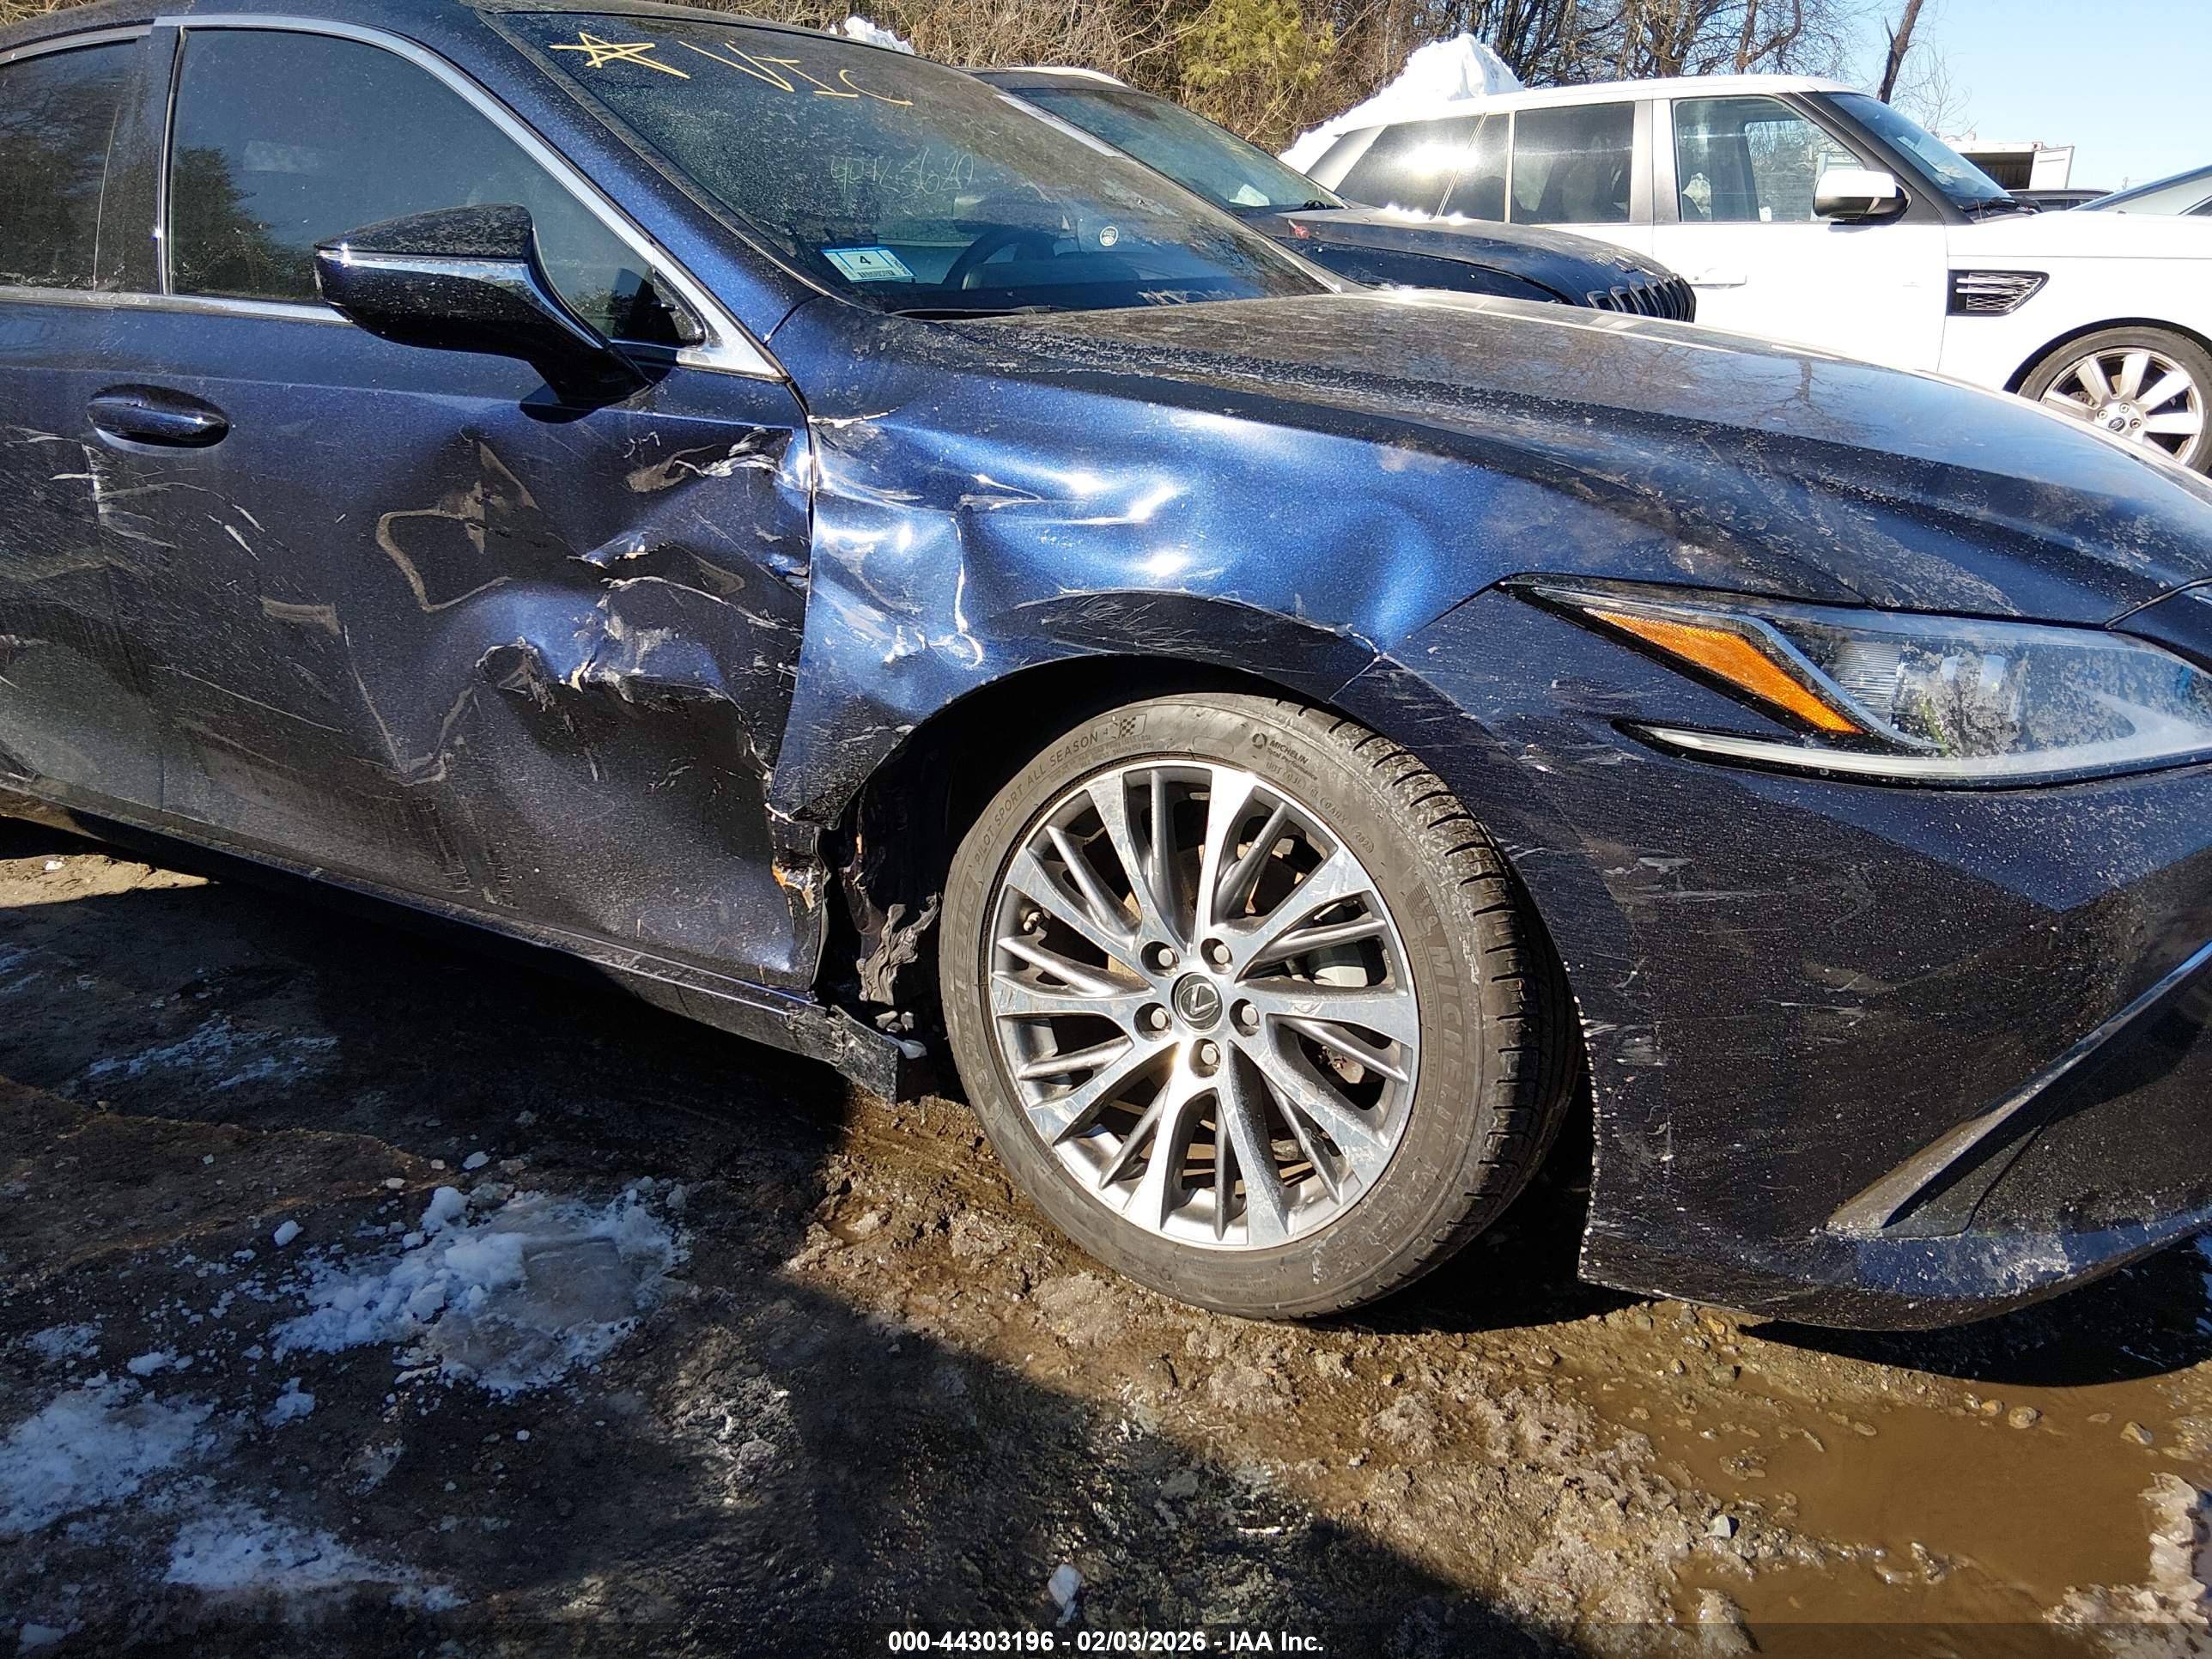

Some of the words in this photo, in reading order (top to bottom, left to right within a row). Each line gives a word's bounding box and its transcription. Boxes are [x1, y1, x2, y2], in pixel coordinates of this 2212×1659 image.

[860, 255, 872, 264] 4
[1269, 739, 1309, 765] MICHELIN
[974, 825, 995, 866] PILOT
[994, 785, 1026, 827] SPORT
[1026, 765, 1047, 786] ALL
[1049, 731, 1099, 767] SEASON
